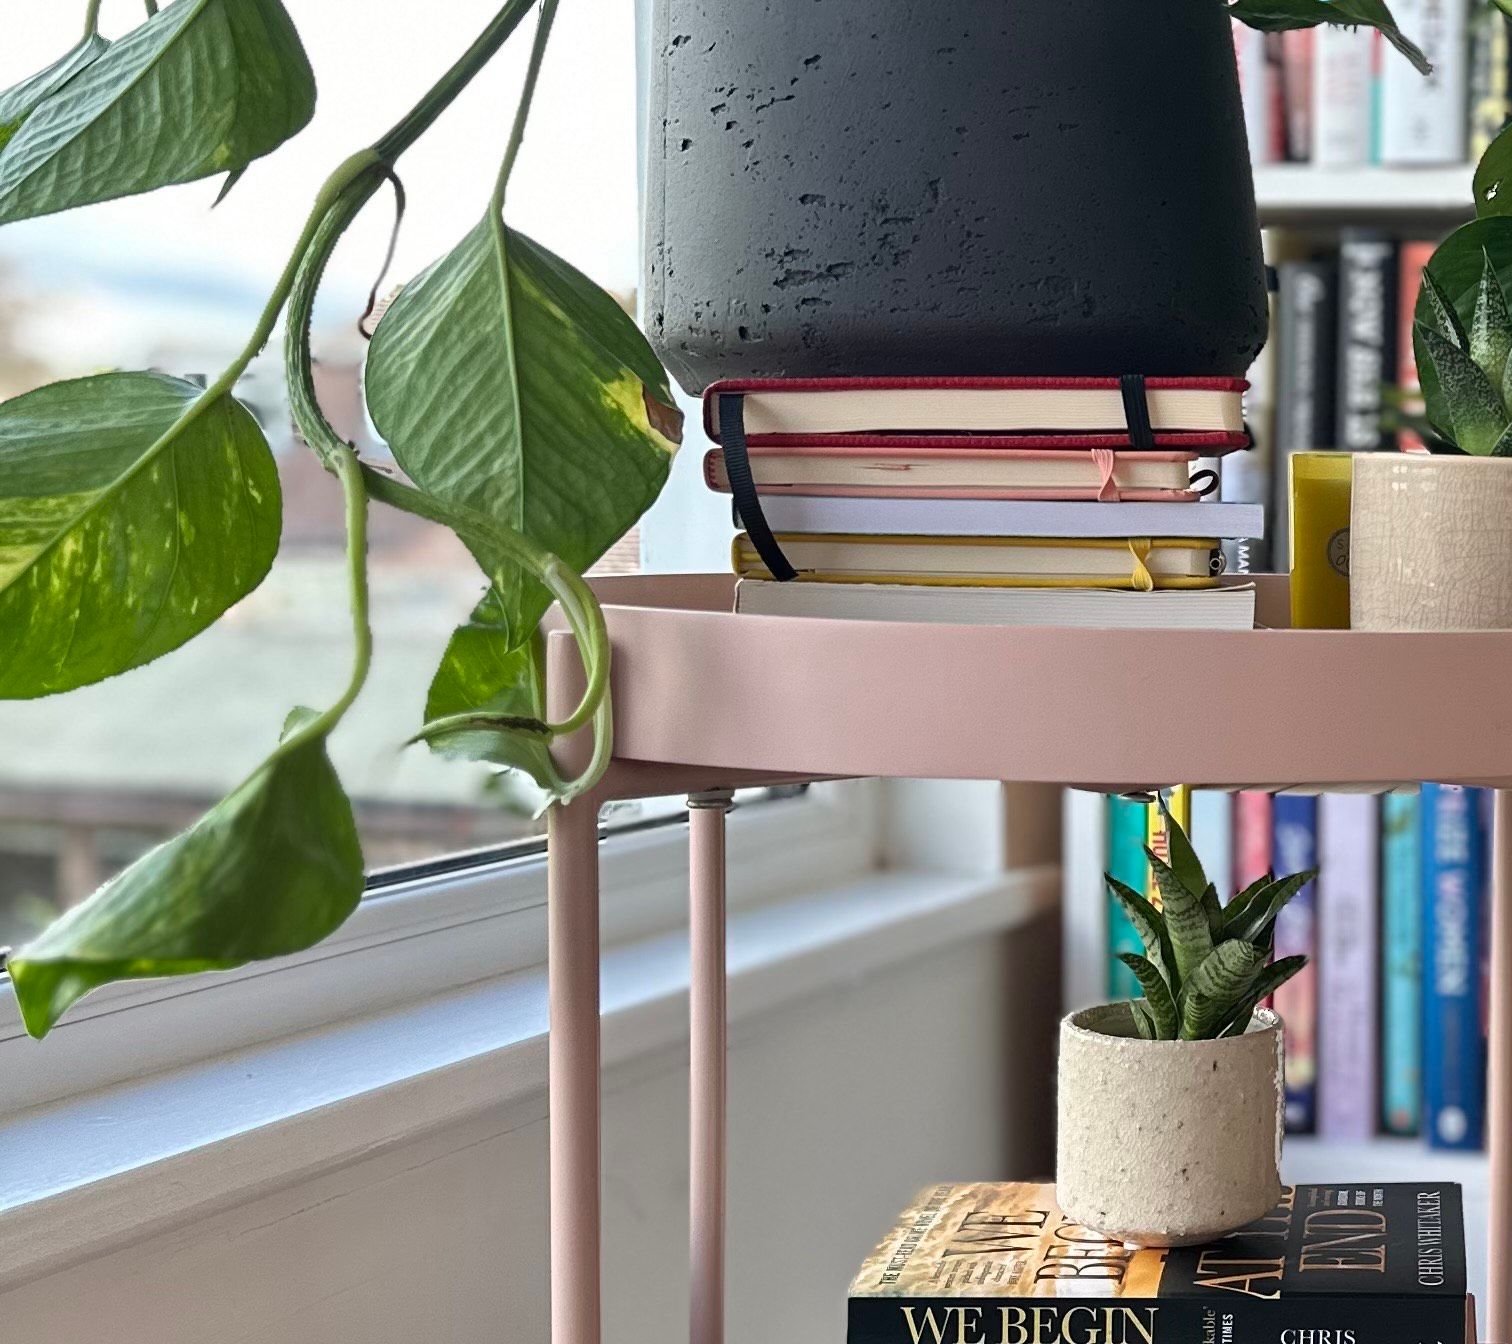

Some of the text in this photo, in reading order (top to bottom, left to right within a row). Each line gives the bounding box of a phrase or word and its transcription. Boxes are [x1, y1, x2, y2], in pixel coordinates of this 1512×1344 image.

[942, 1210, 1051, 1258] WE
[1299, 1209, 1388, 1273] END
[1417, 1190, 1445, 1287] CHRIS WHITAKER
[1221, 1313, 1233, 1344] TIMES
